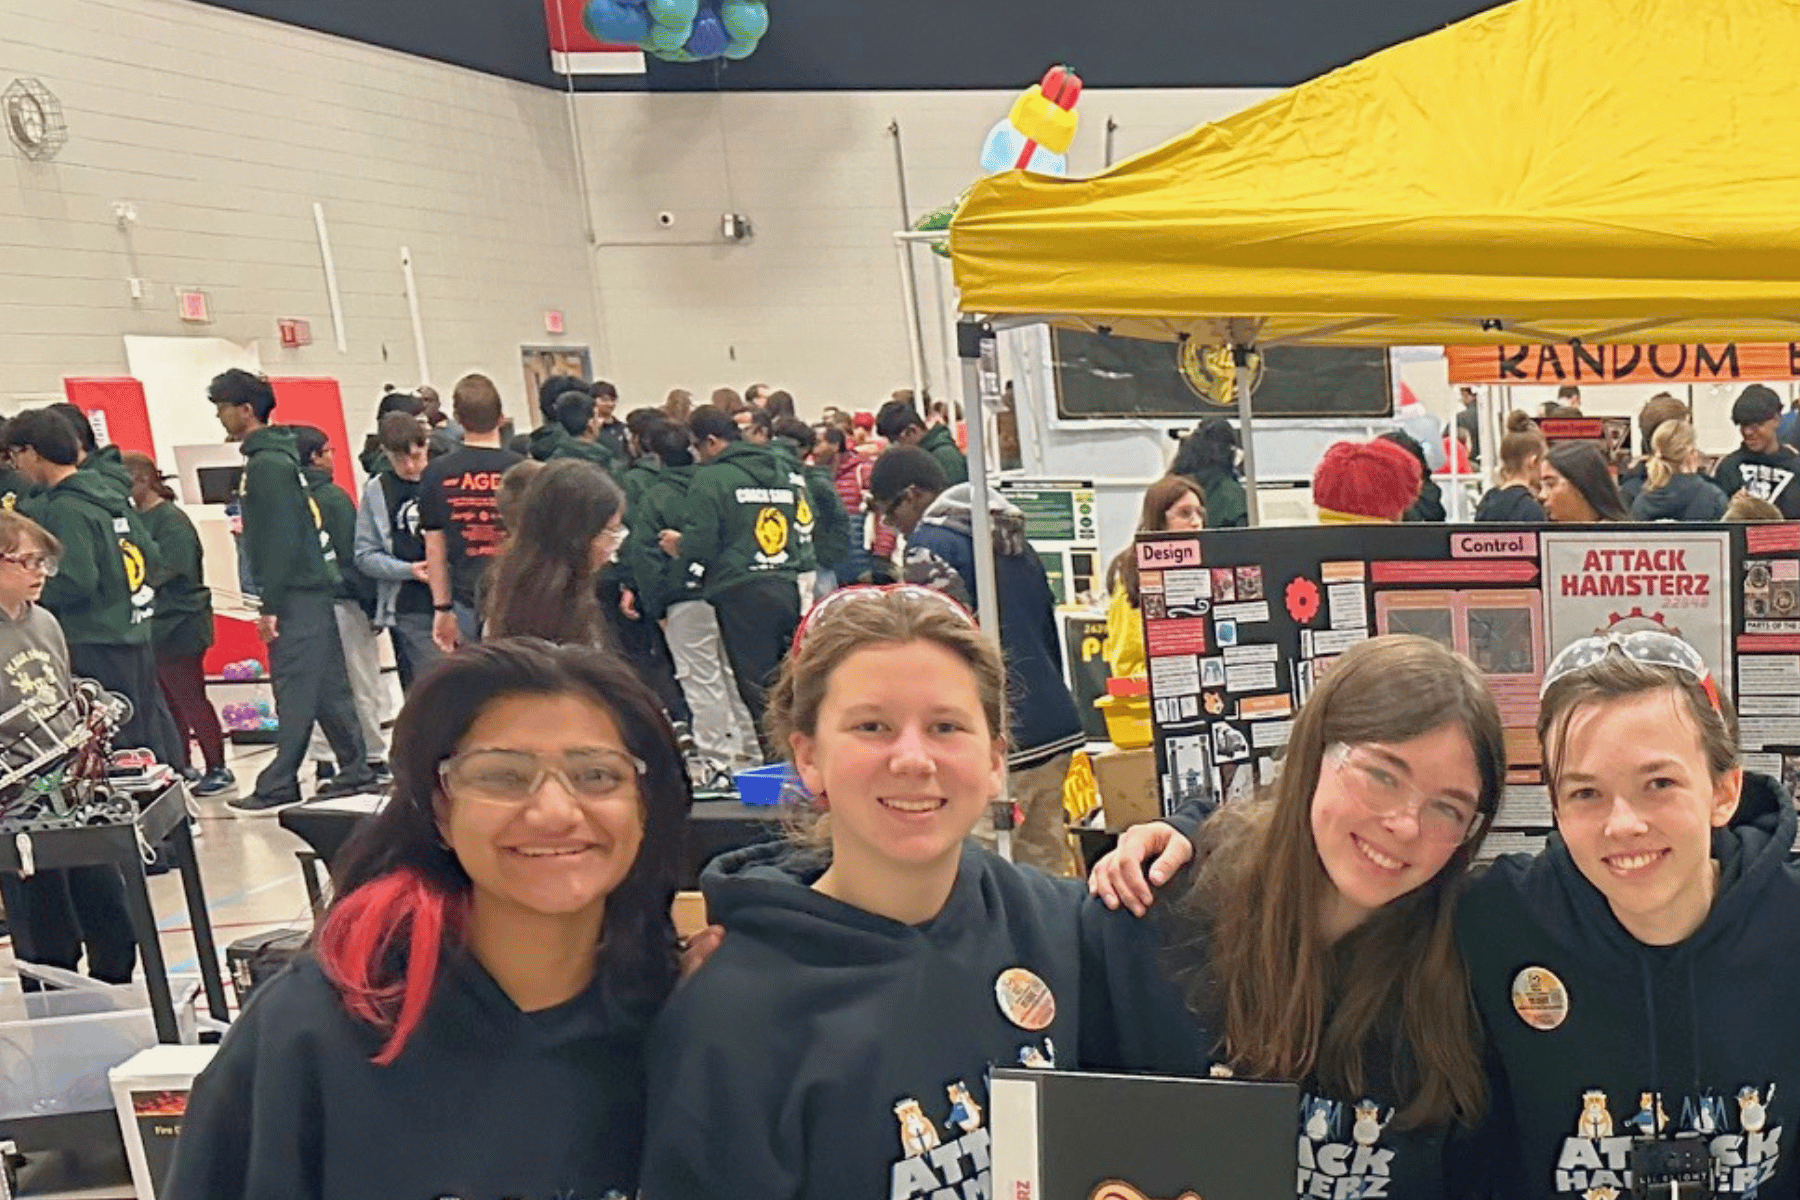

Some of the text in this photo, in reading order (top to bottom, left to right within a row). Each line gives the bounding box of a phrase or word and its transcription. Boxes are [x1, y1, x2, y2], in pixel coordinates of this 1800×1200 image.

[1498, 343, 1740, 379] RANDOM
[1143, 545, 1193, 563] Design
[1460, 537, 1524, 553] Control
[1582, 549, 1687, 572] ATTACK
[1561, 574, 1710, 597] HAMSTERZ
